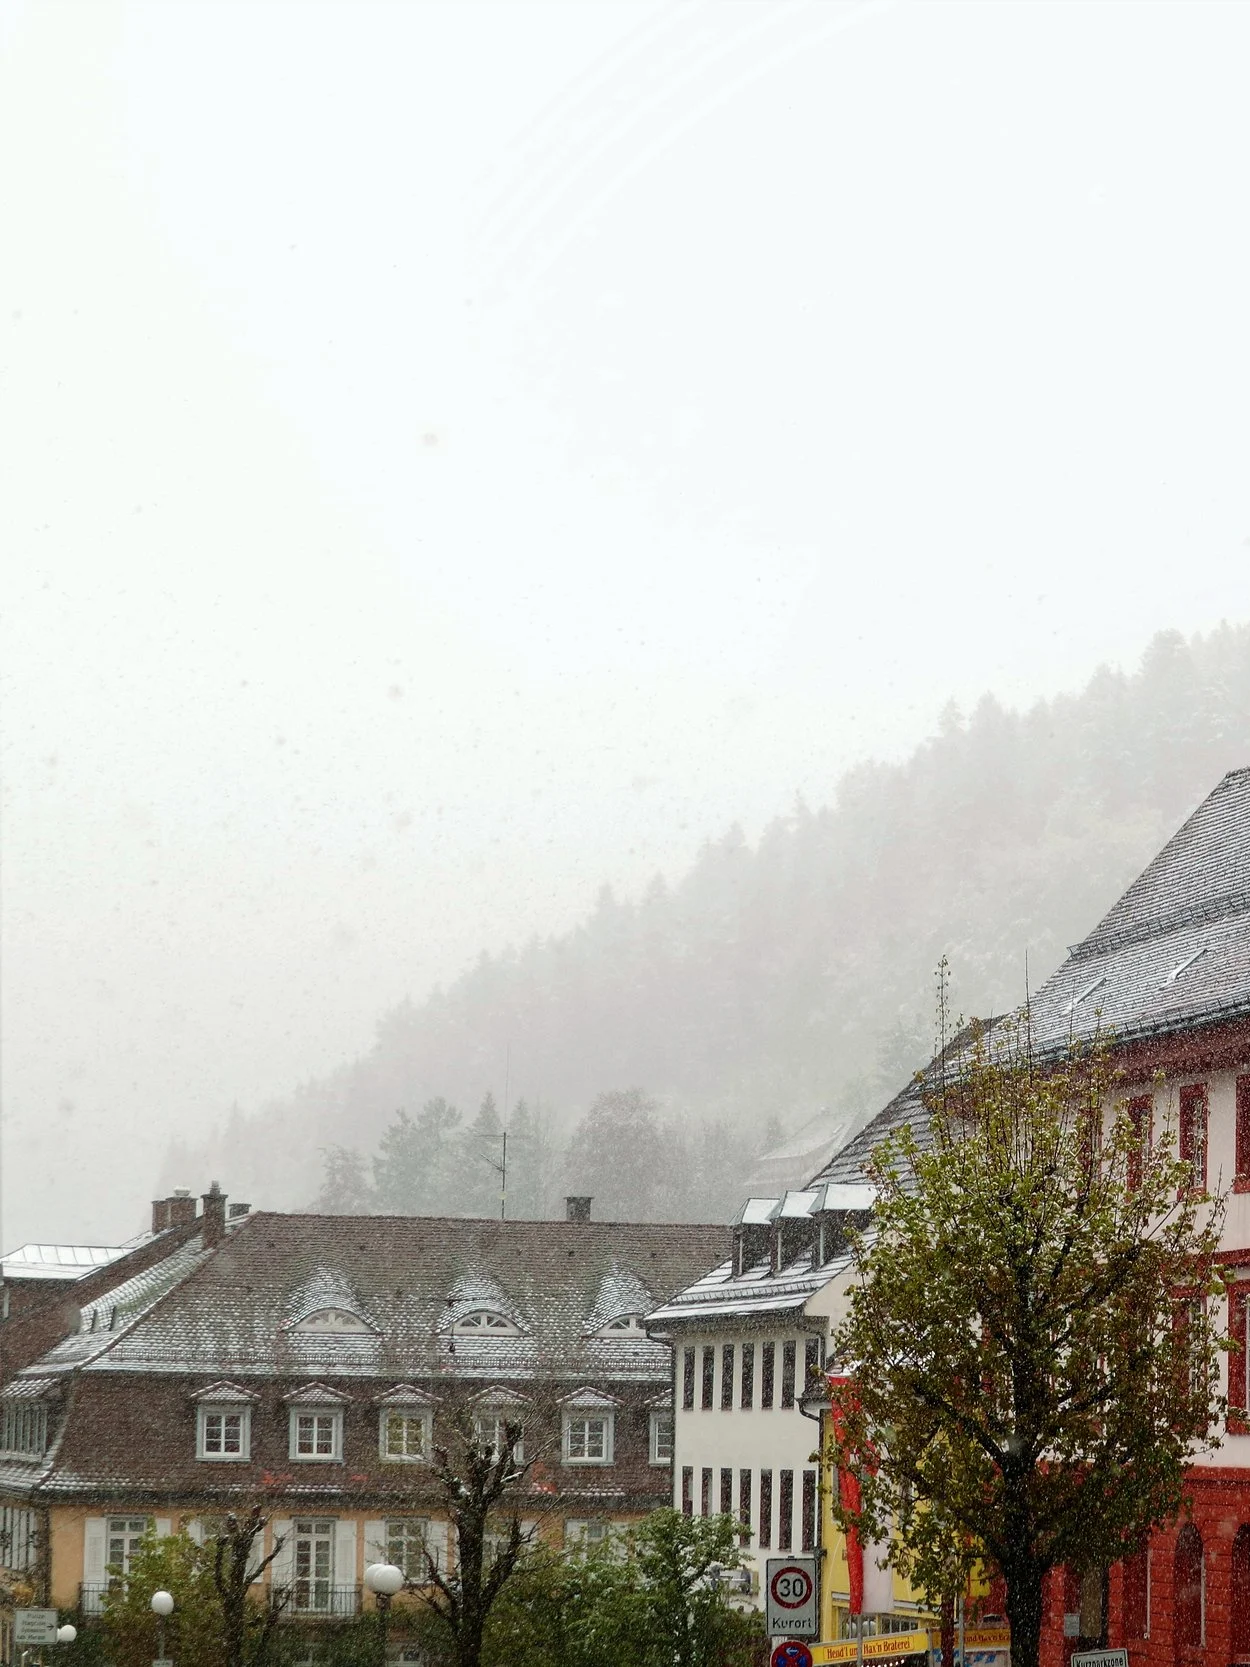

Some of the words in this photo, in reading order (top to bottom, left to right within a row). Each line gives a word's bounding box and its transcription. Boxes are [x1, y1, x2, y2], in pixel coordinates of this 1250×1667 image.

[780, 1578, 803, 1597] 30
[772, 1617, 811, 1629] Kurort
[883, 1638, 910, 1653] Braterei
